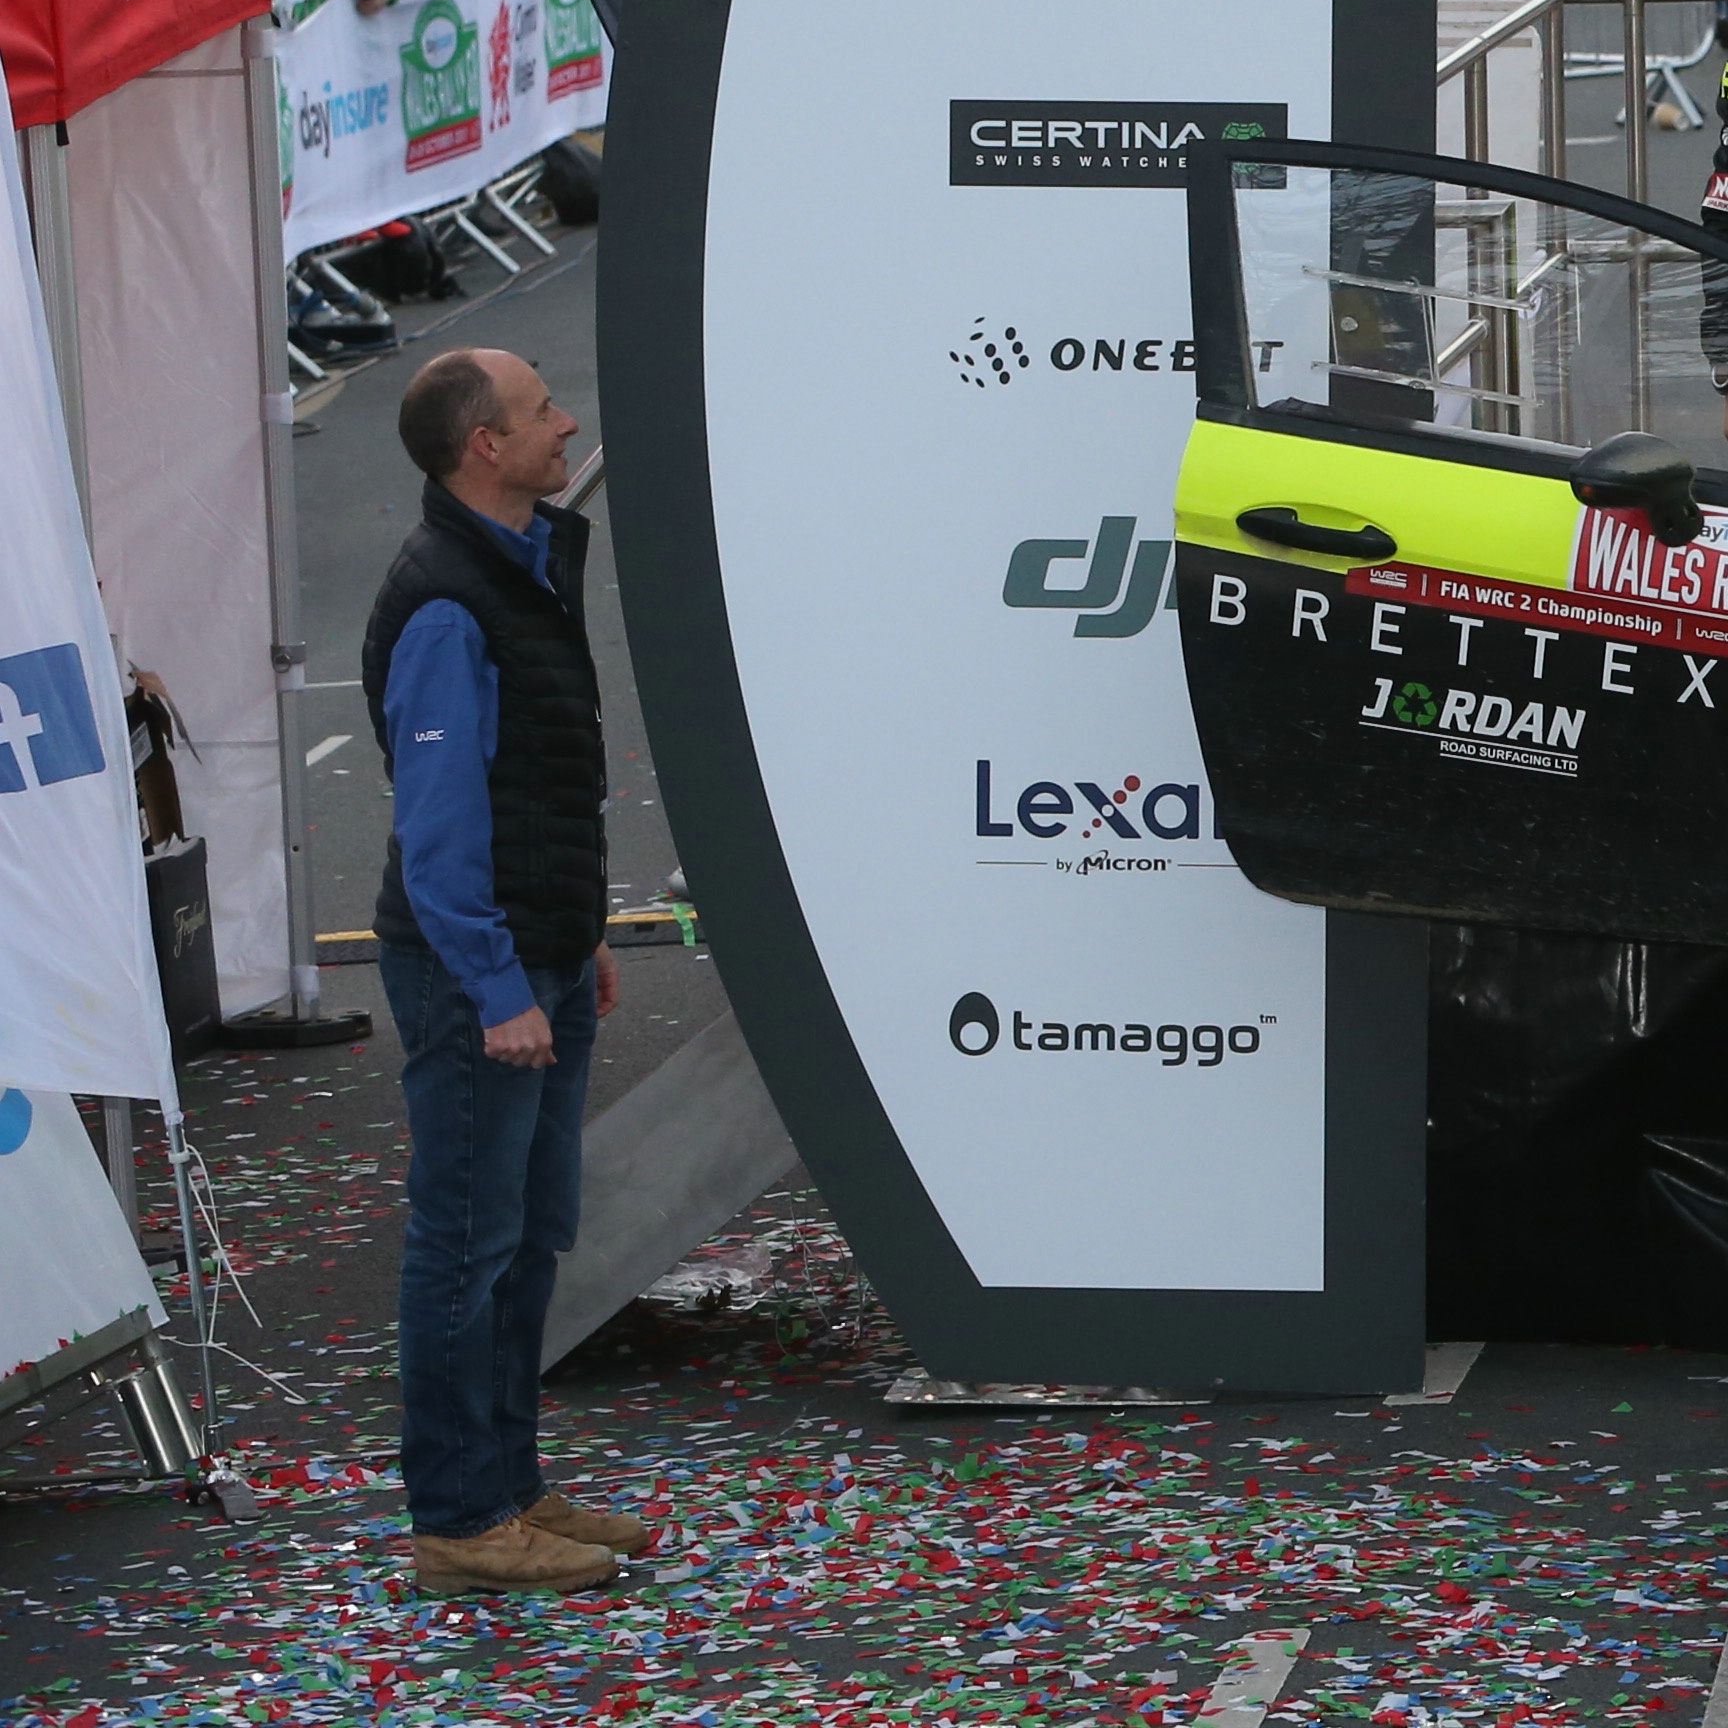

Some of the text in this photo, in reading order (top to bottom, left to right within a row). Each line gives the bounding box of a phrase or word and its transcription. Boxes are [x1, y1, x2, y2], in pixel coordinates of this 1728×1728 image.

[299, 80, 389, 158] dayinsure
[970, 119, 1205, 150] CERTINA
[975, 155, 1188, 168] SWISS WATCHE
[1587, 510, 1704, 608] WALES
[1440, 580, 1664, 637] FIA WRC Championship
[1209, 574, 1718, 709] BRETTEX
[415, 728, 445, 742] WRC
[1440, 740, 1578, 771] ROAD SURFACING LTD
[1055, 858, 1073, 874] by
[1012, 1010, 1262, 1067] tamaggo
